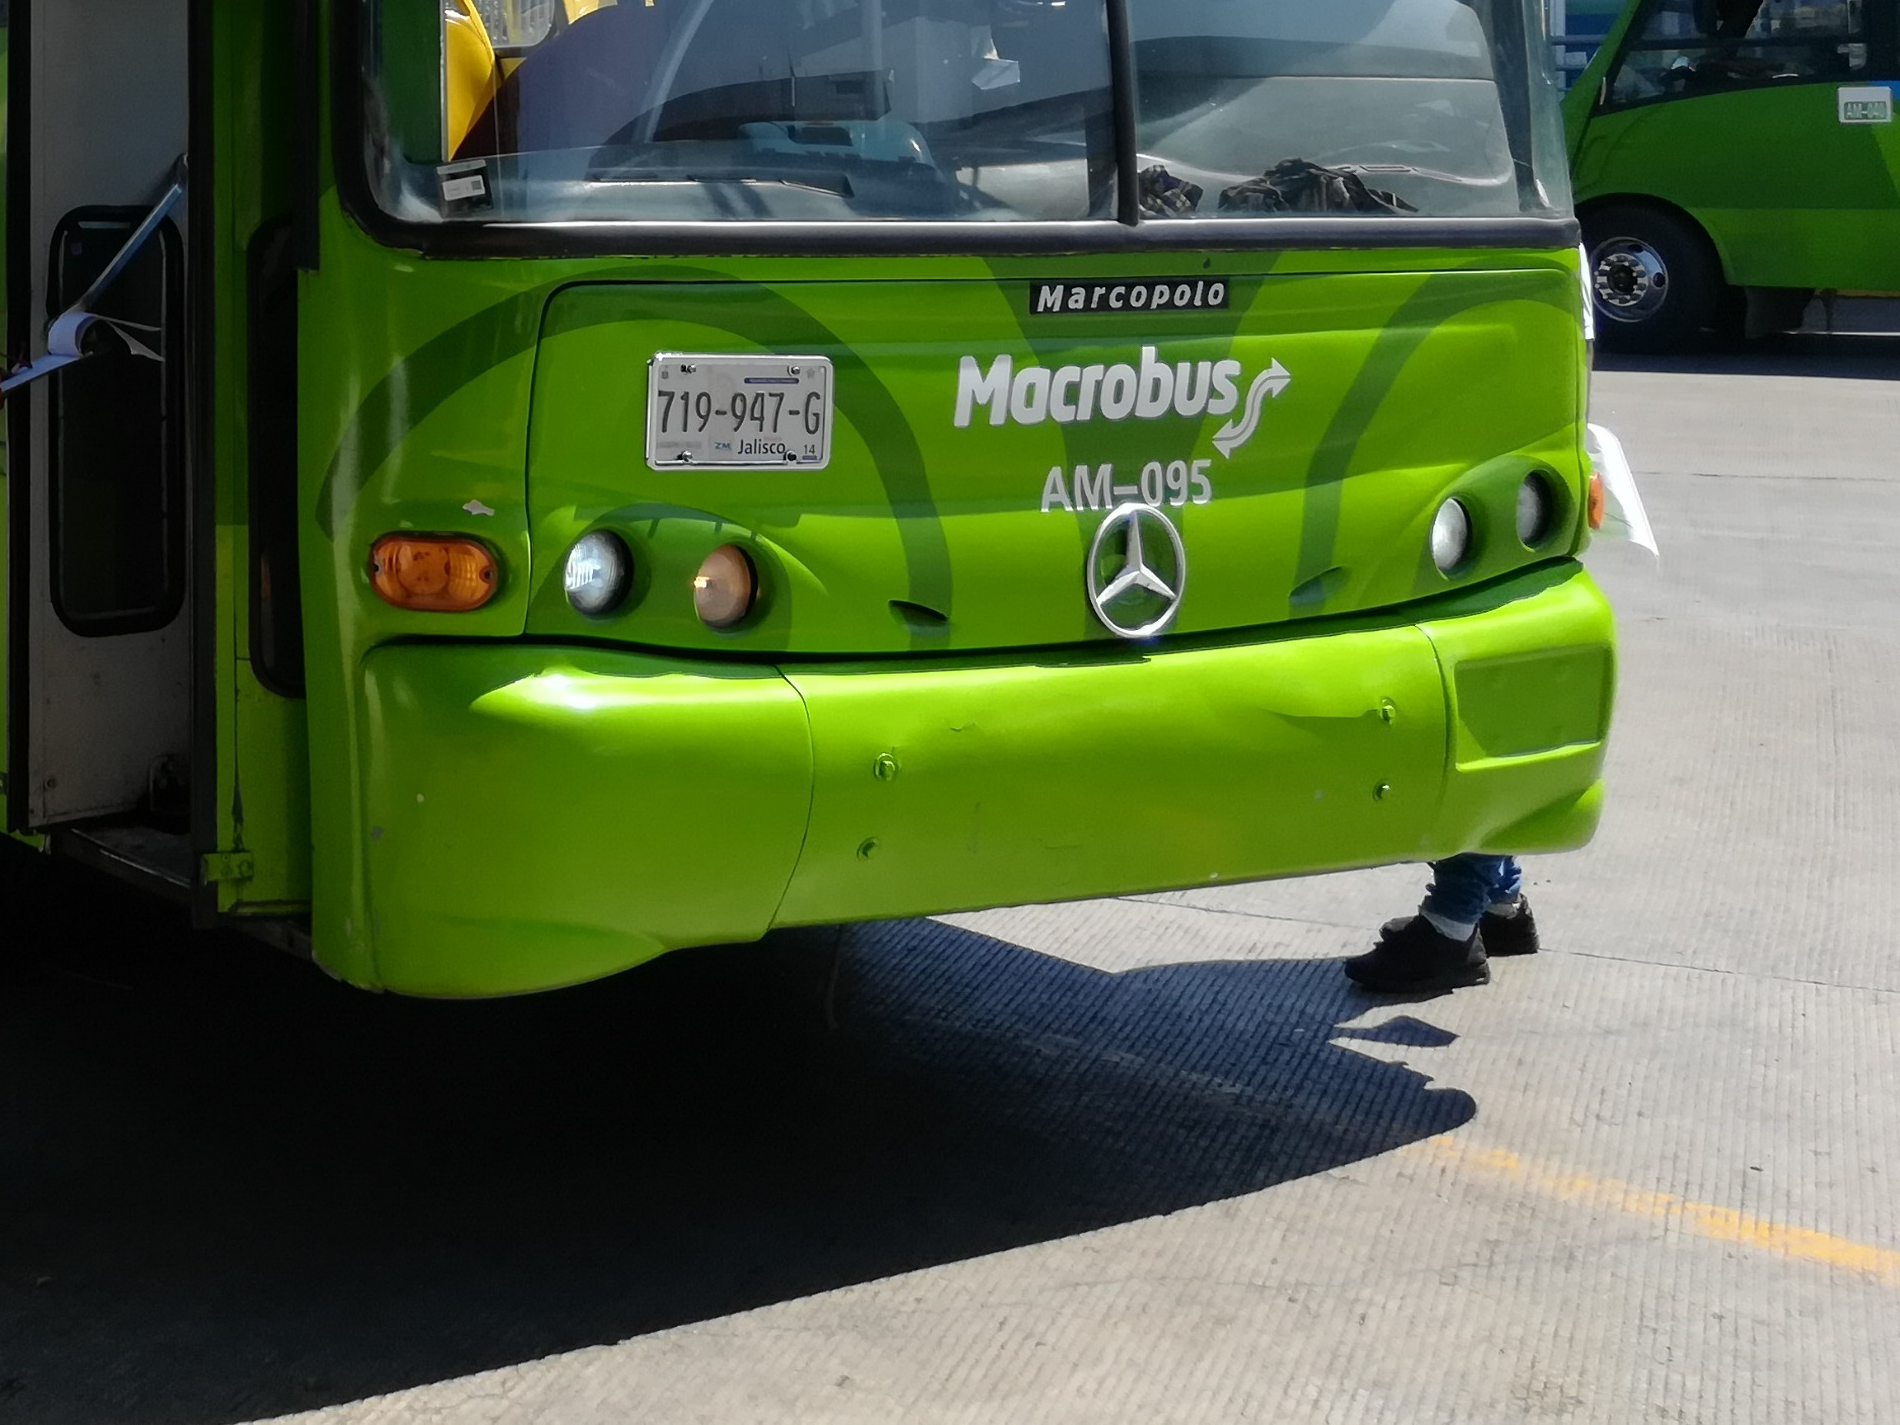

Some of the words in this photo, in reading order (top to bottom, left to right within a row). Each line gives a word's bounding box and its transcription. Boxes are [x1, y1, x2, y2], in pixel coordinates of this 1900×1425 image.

[1036, 280, 1226, 313] Marcopolo
[953, 344, 1242, 428] Macrobus
[657, 390, 821, 435] 719-947-G
[737, 438, 786, 455] Jalisco
[803, 444, 816, 455] 14
[1040, 459, 1213, 513] AM-095
